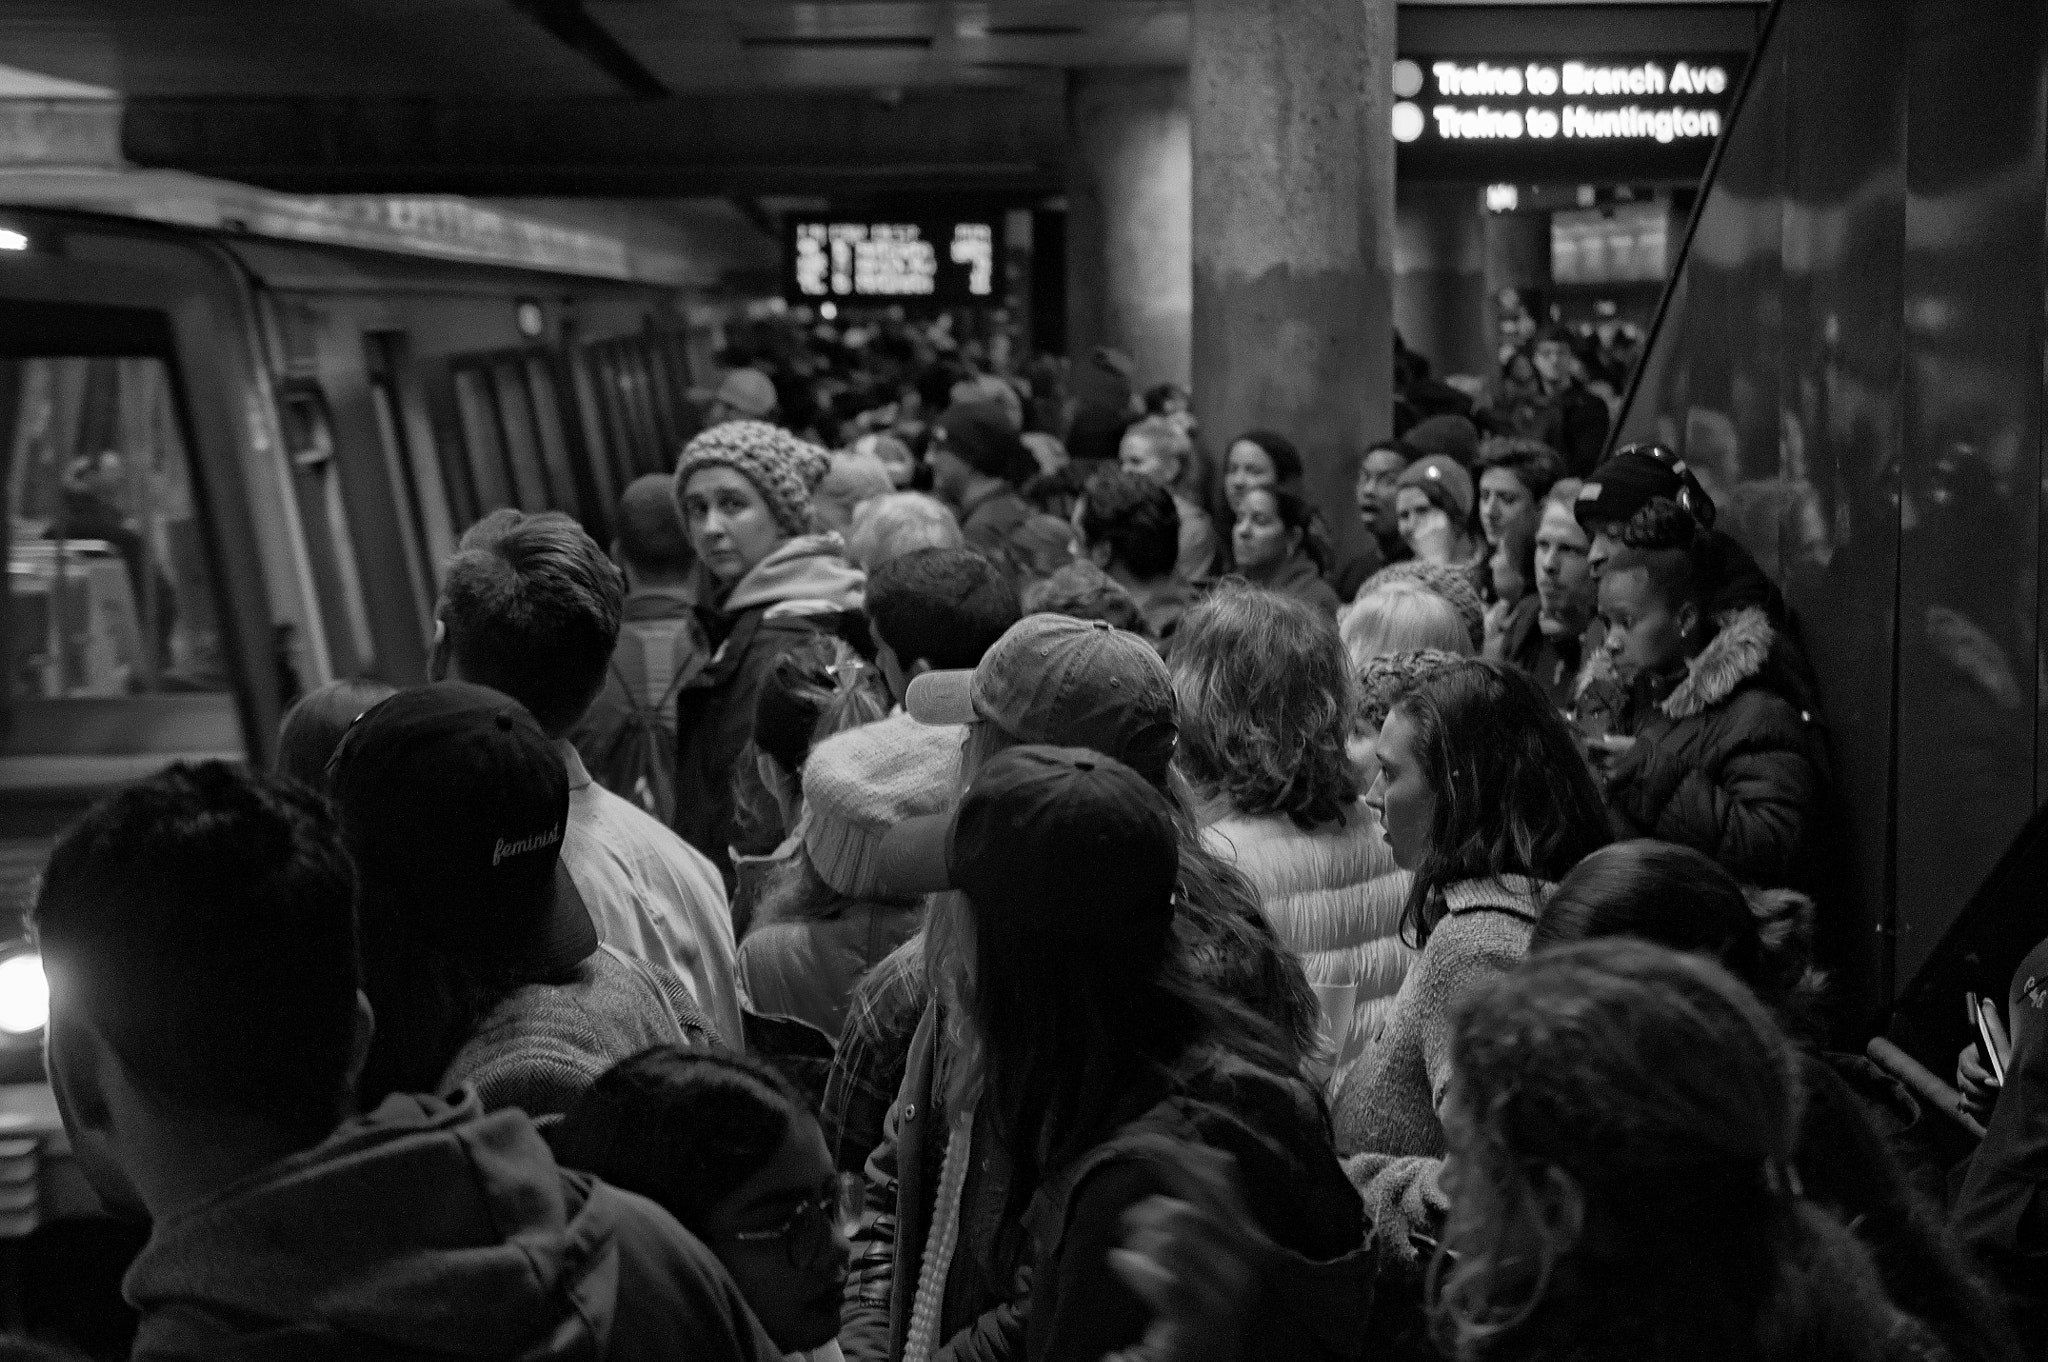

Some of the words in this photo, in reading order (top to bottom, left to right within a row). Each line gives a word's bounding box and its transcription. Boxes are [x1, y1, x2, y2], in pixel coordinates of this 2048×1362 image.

[1432, 61, 1524, 96] Trains
[1525, 61, 1560, 96] to
[1562, 61, 1667, 95] Branch
[1669, 61, 1727, 95] Ave
[1432, 105, 1524, 139] Trains
[1525, 105, 1560, 139] to
[1562, 105, 1720, 143] Huntington
[492, 821, 561, 867] feminist
